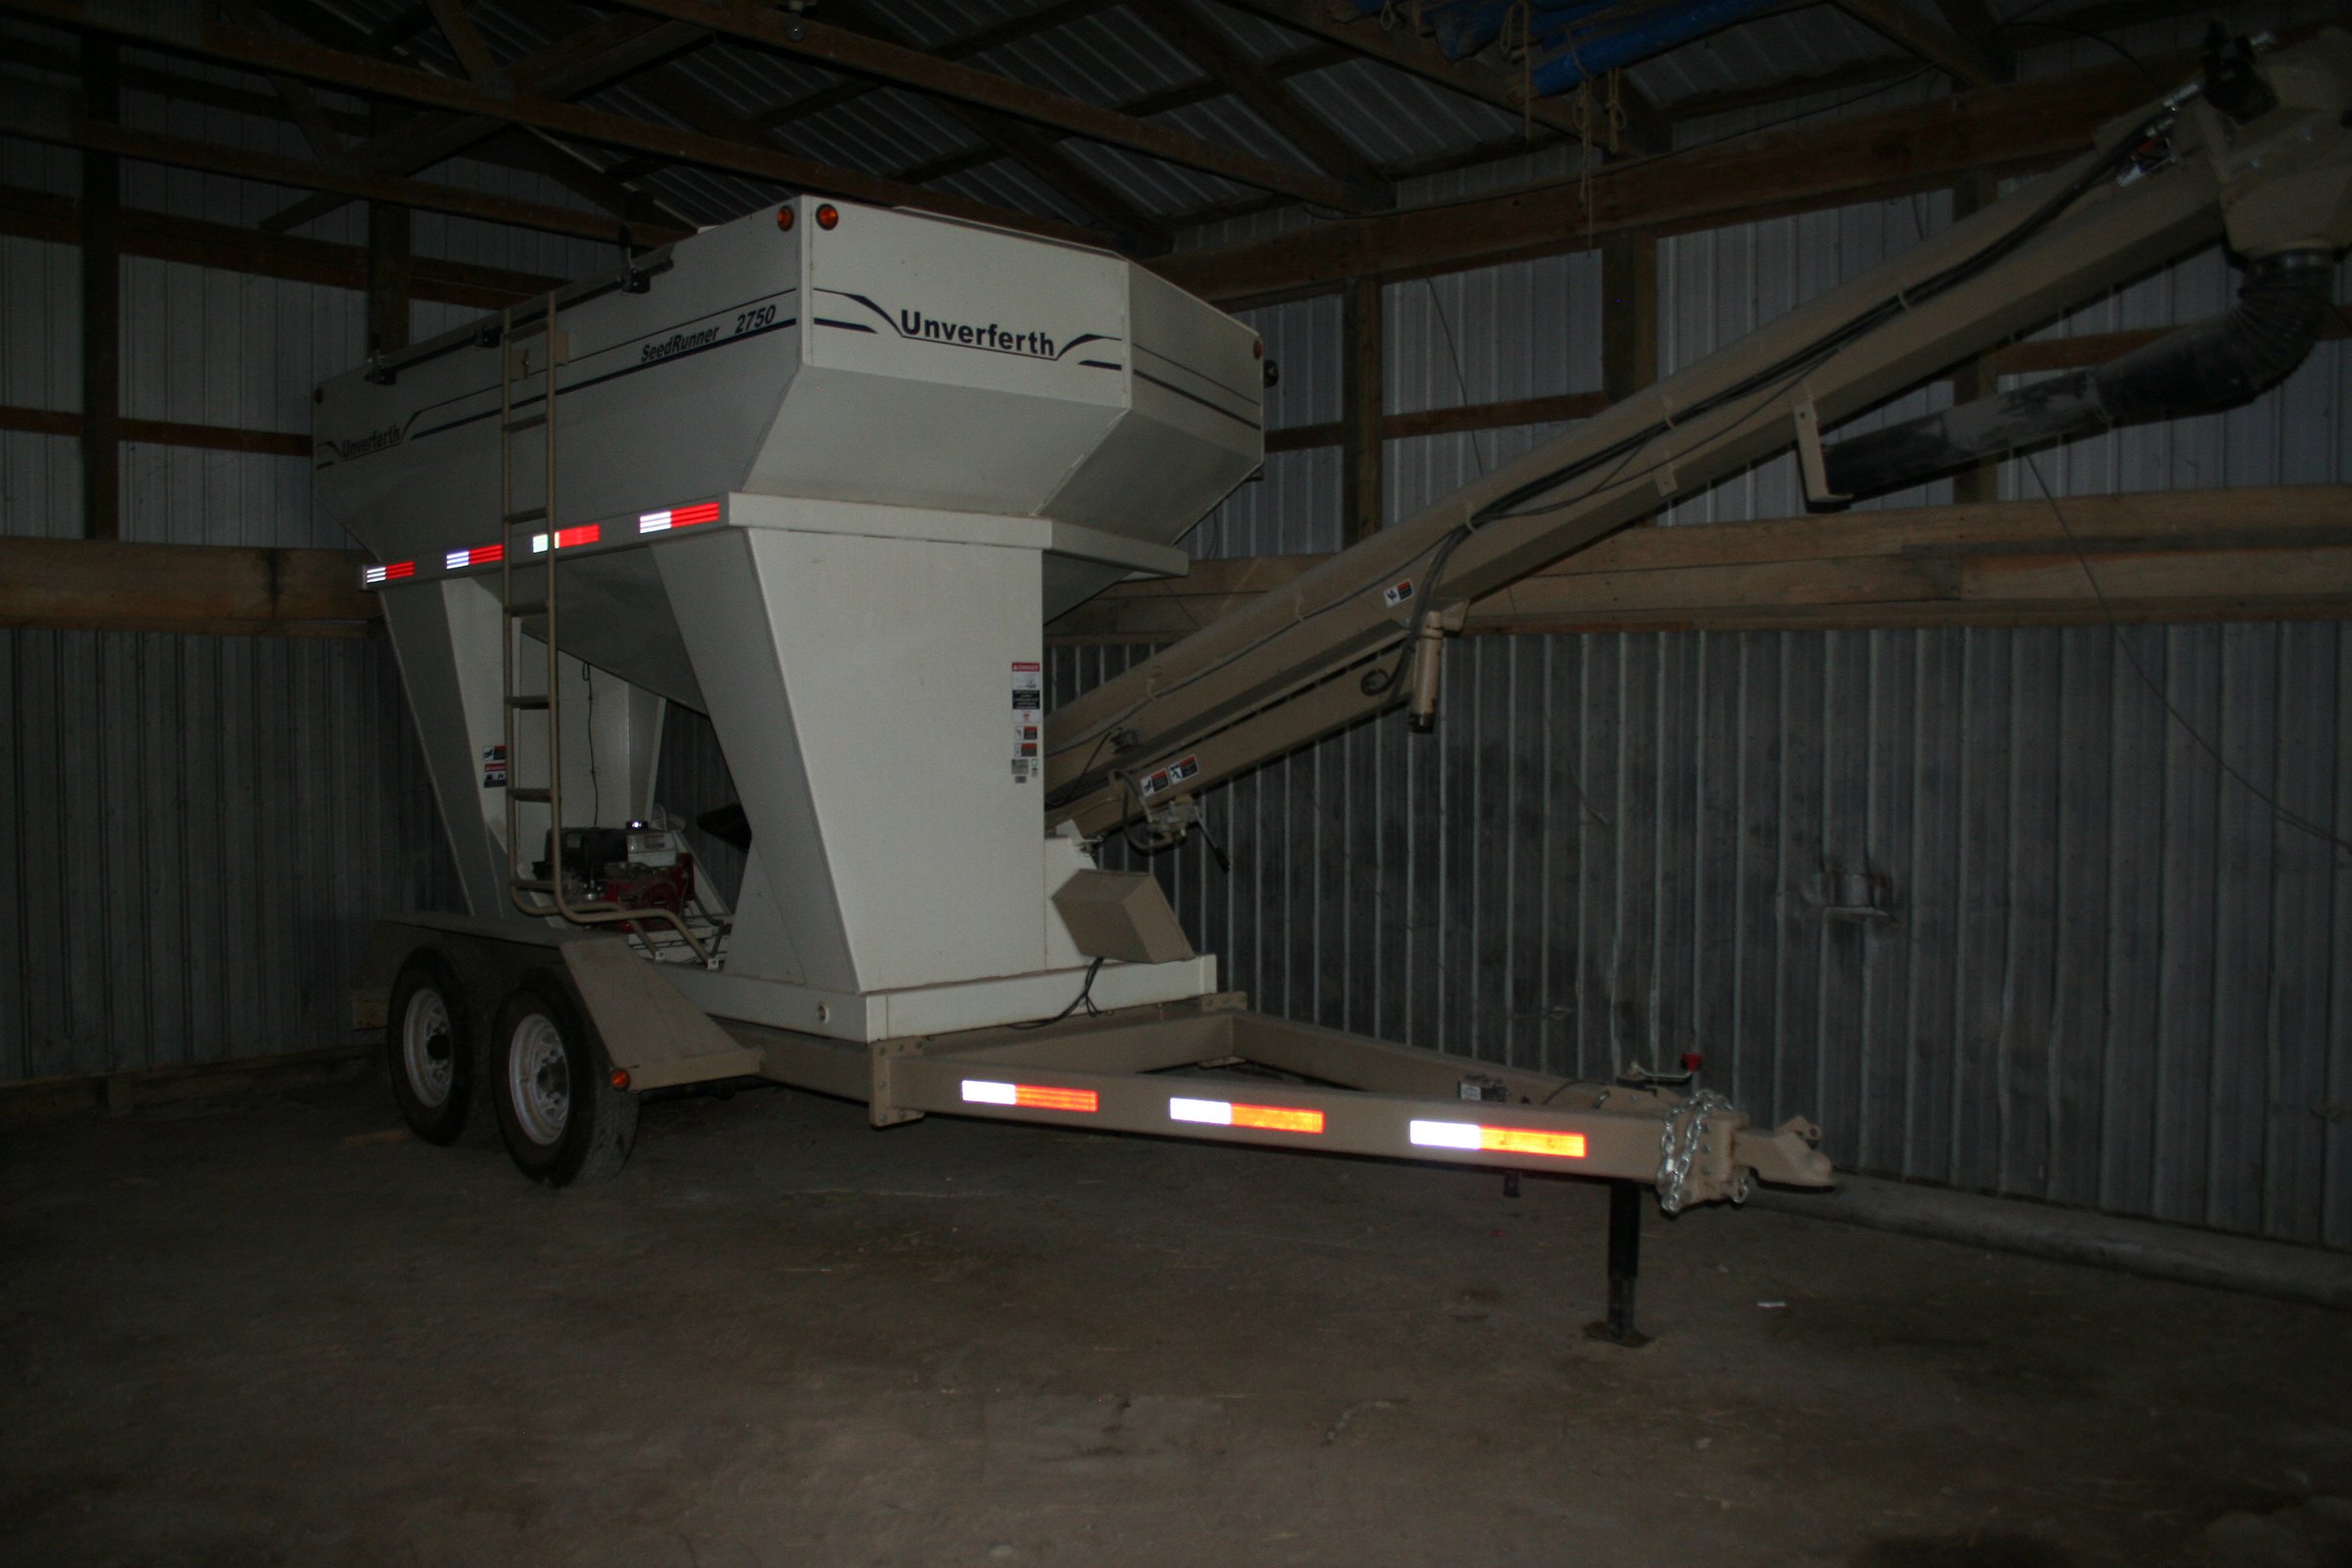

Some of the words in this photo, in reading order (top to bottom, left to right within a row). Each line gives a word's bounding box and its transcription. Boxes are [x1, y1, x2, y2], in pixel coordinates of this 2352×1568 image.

[642, 326, 719, 362] SeedRunner
[735, 305, 776, 333] 2750
[901, 309, 1054, 356] Unverferth
[342, 424, 400, 457] Unverferth
